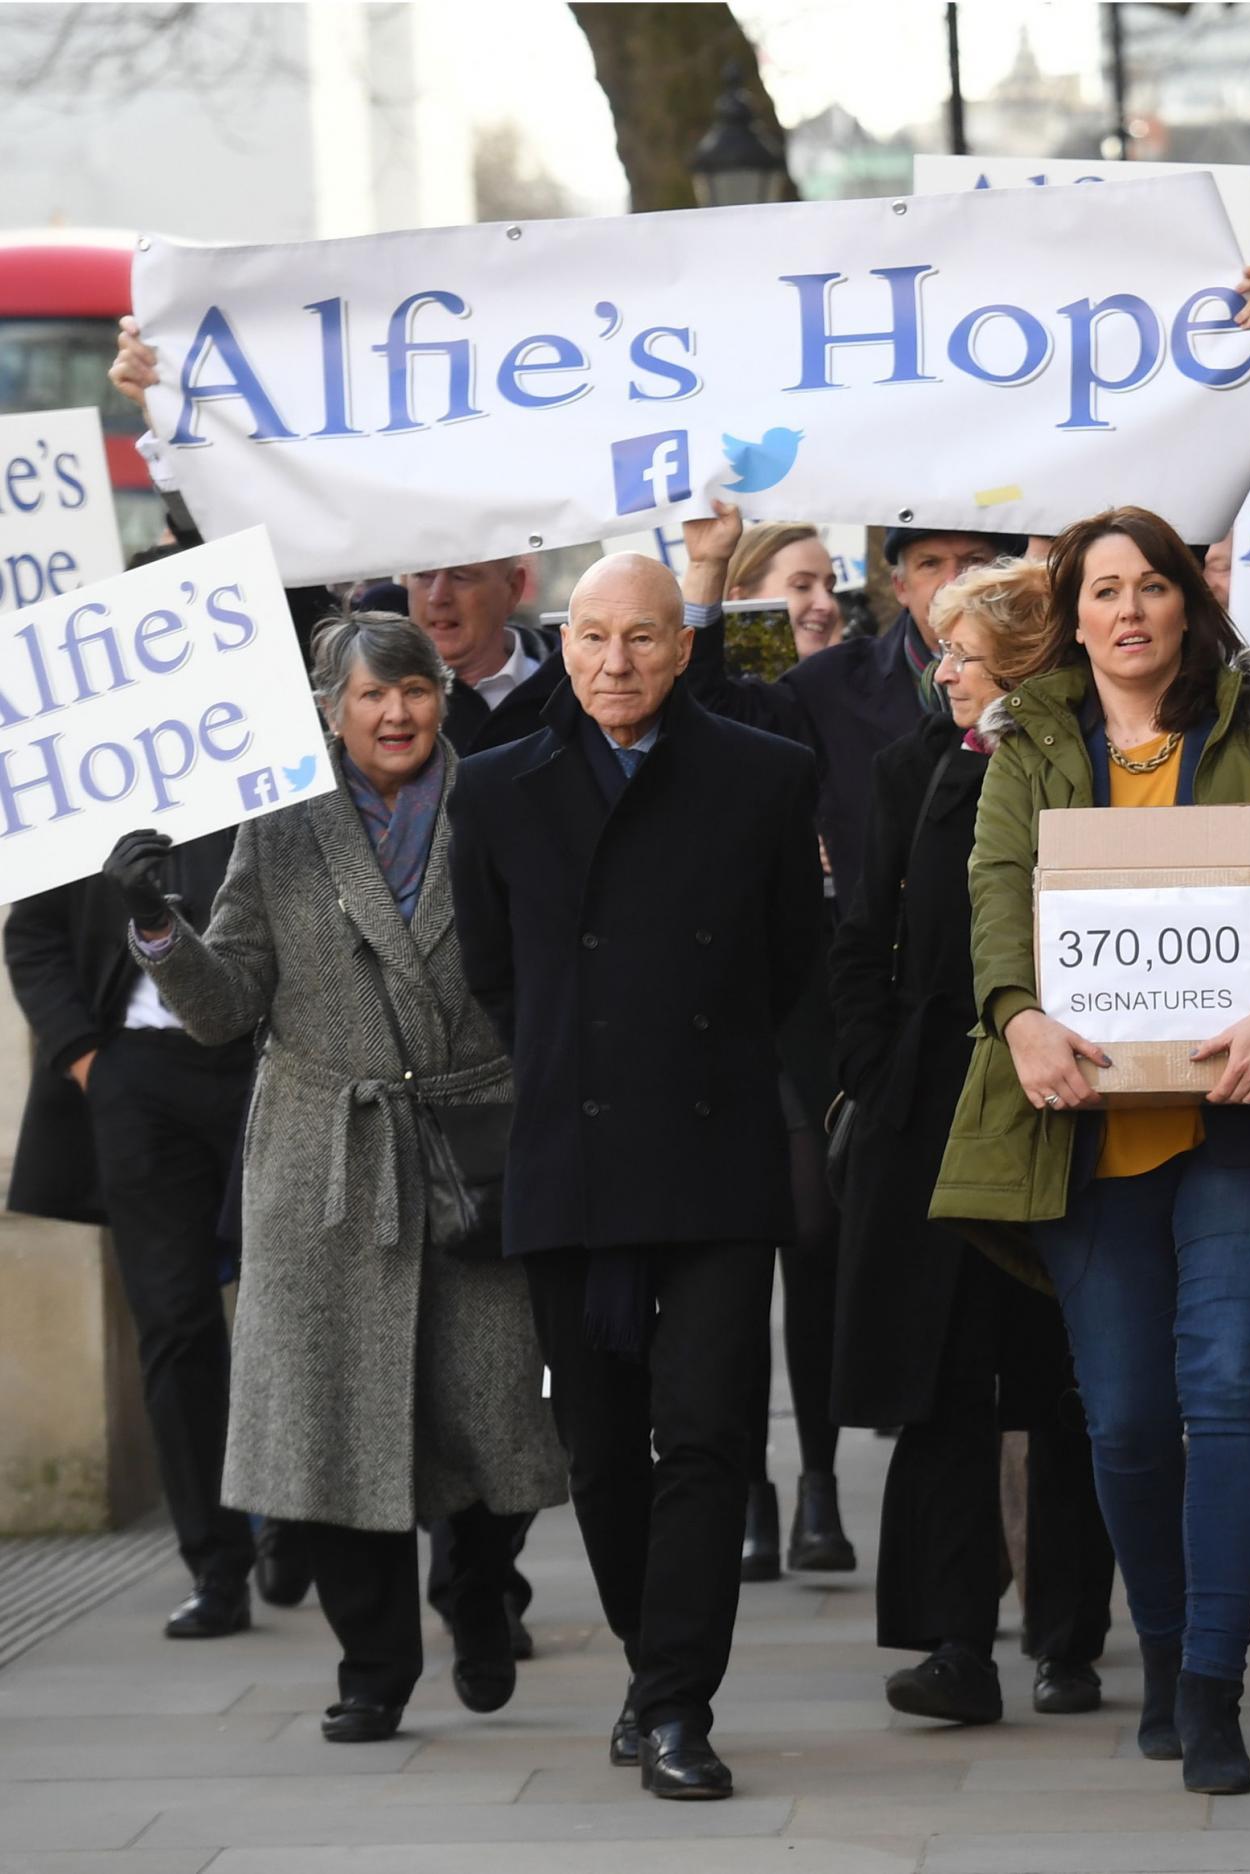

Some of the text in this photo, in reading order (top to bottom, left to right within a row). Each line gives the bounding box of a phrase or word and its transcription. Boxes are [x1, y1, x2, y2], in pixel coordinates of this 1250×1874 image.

[168, 289, 701, 448] Alfie's
[0, 702, 253, 838] Hope
[1058, 926, 1240, 972] 370,000
[1070, 989, 1233, 1012] SIGNATURES
